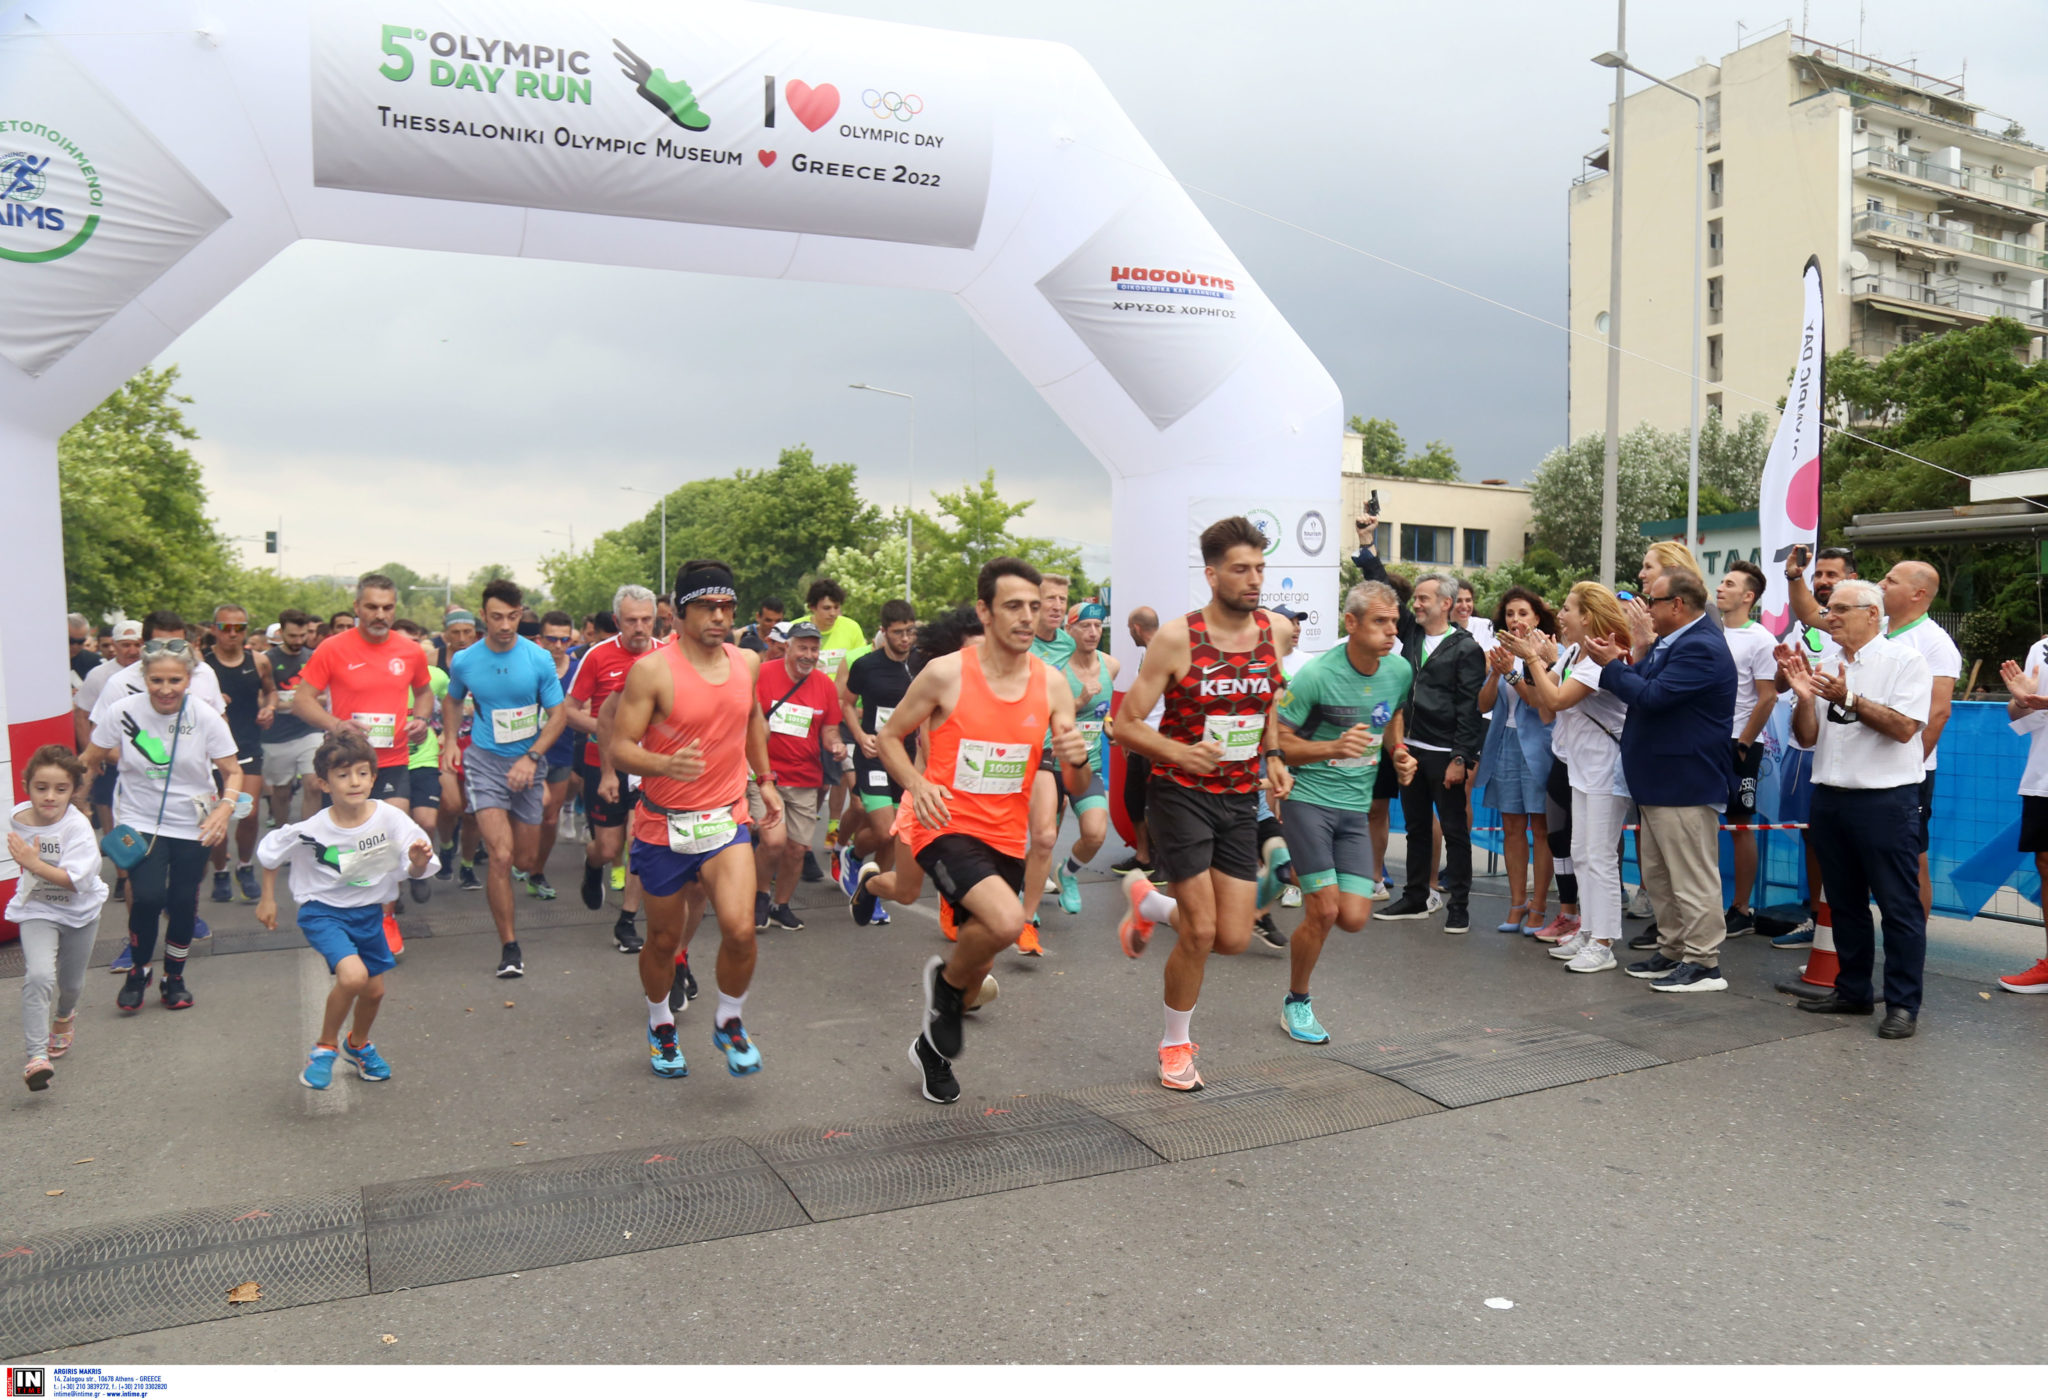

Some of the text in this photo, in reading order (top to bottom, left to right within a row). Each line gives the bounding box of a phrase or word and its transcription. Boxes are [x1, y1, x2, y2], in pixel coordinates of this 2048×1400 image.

[430, 31, 591, 75] OLYMPIC
[430, 58, 592, 104] DAY RUN
[764, 75, 776, 128] I
[378, 106, 941, 188] THESSALONIKI OLYMPIC MUSEUM GREECE 2022
[840, 124, 944, 149] OLYMPIC DAY
[1110, 266, 1235, 291] μασούτης
[1112, 301, 1237, 319] ΧΡΥΣΟΣ ΧΟΡΗΓΟΣ
[1199, 678, 1271, 697] KENYA
[168, 724, 193, 736] 002
[989, 763, 1022, 774] 10012
